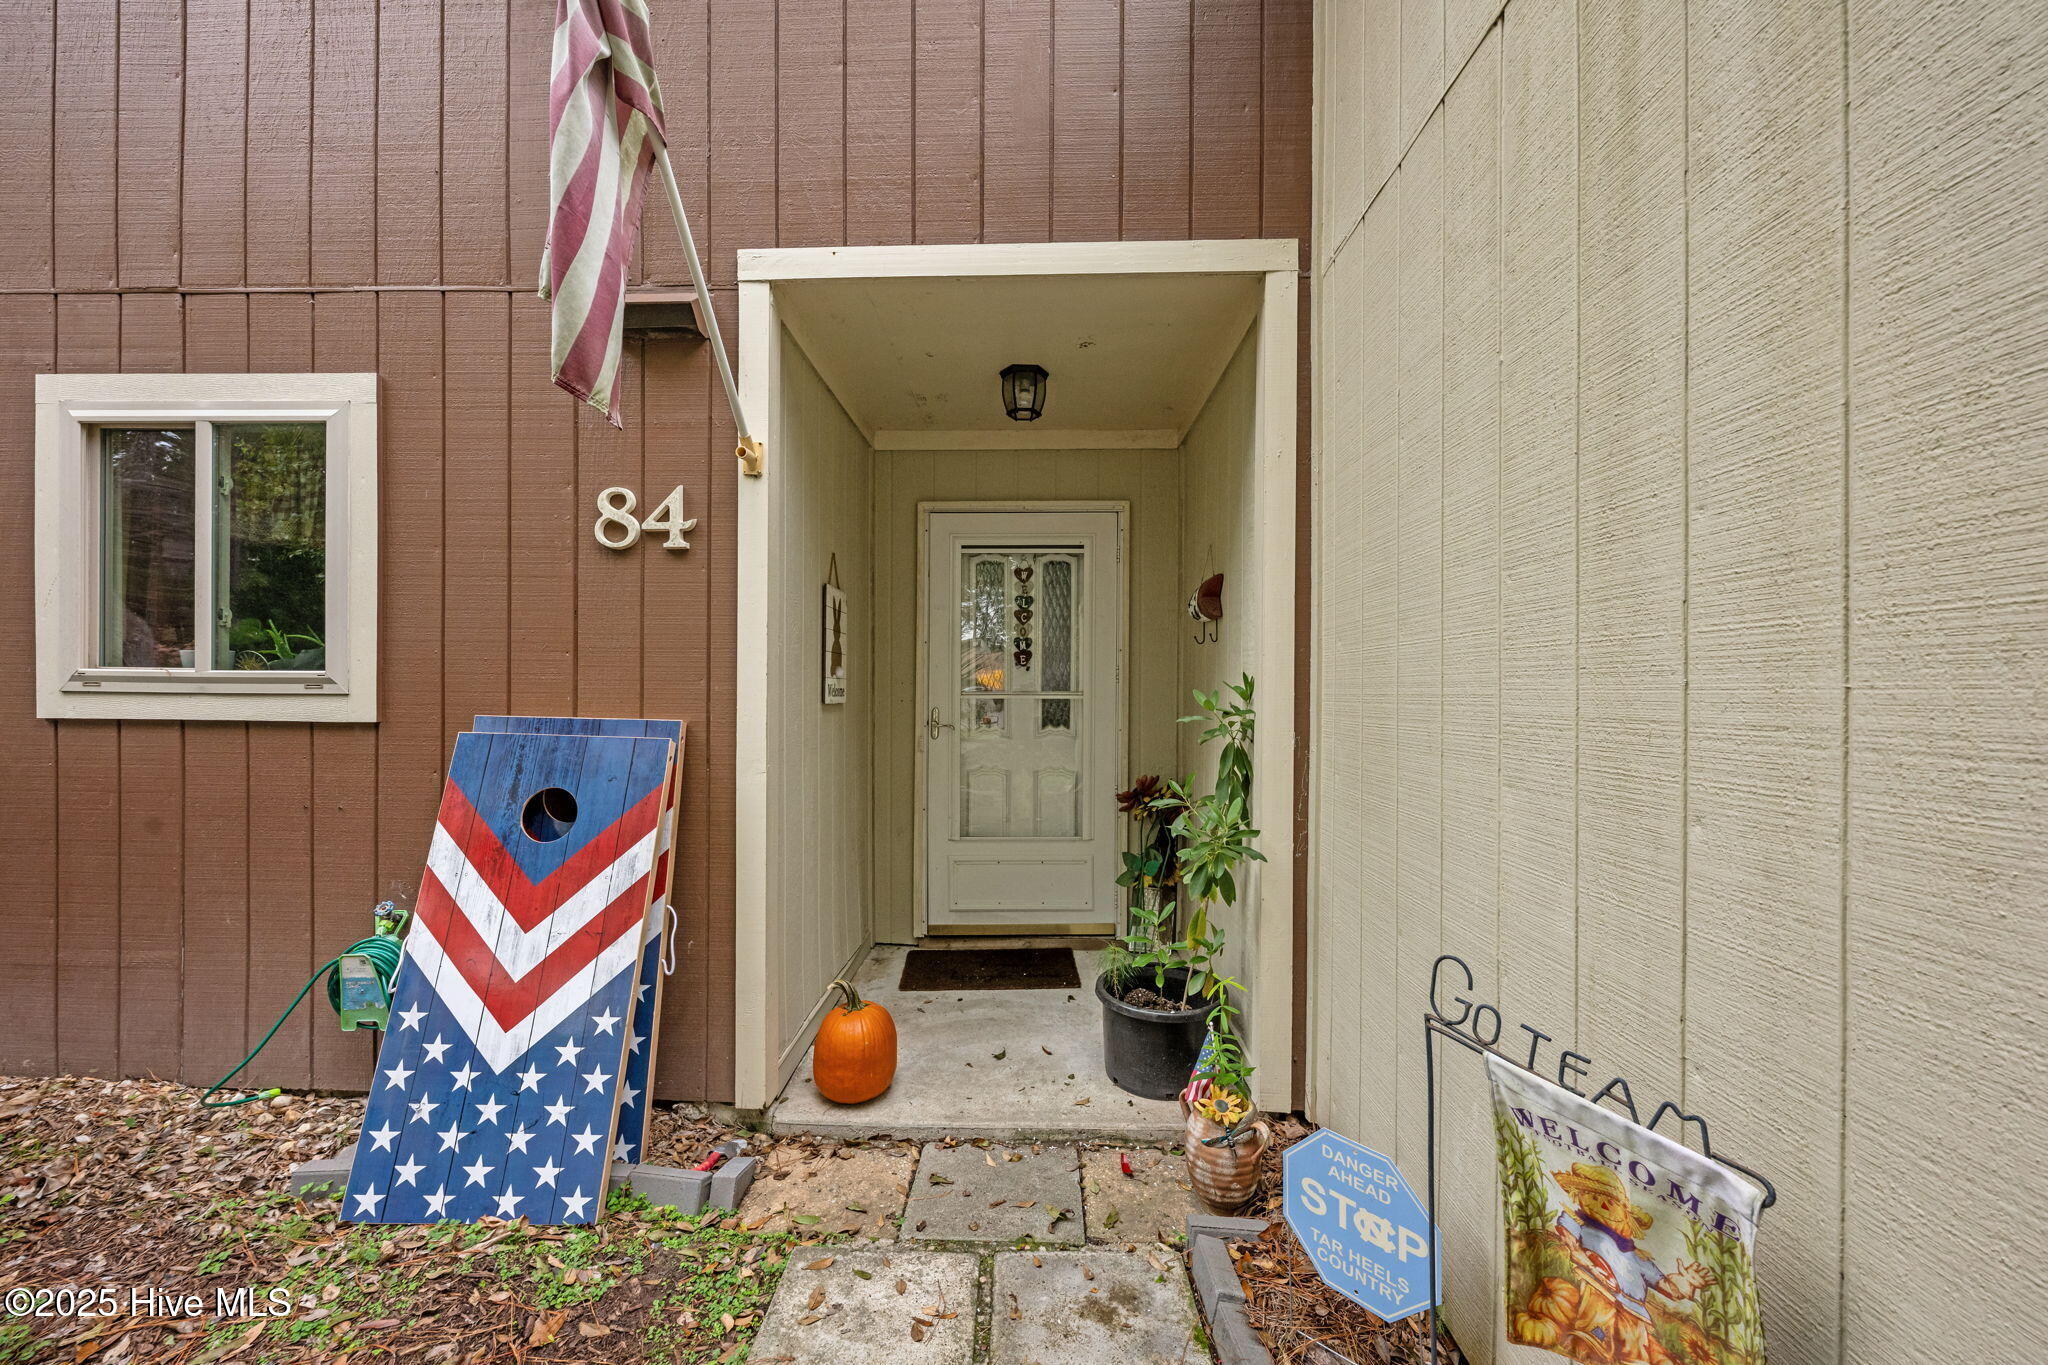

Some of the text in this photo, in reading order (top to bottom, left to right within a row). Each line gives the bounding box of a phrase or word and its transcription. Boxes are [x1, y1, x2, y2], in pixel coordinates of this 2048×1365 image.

[594, 485, 698, 550] 84
[1520, 1023, 1711, 1158] TEAM
[1321, 1144, 1400, 1192] DANGER
[1328, 1166, 1391, 1205] AHEAD
[1509, 1105, 1741, 1242] WELCOME
[1310, 1227, 1410, 1294] TAR HEELS
[1316, 1246, 1406, 1306] COUNTRY
